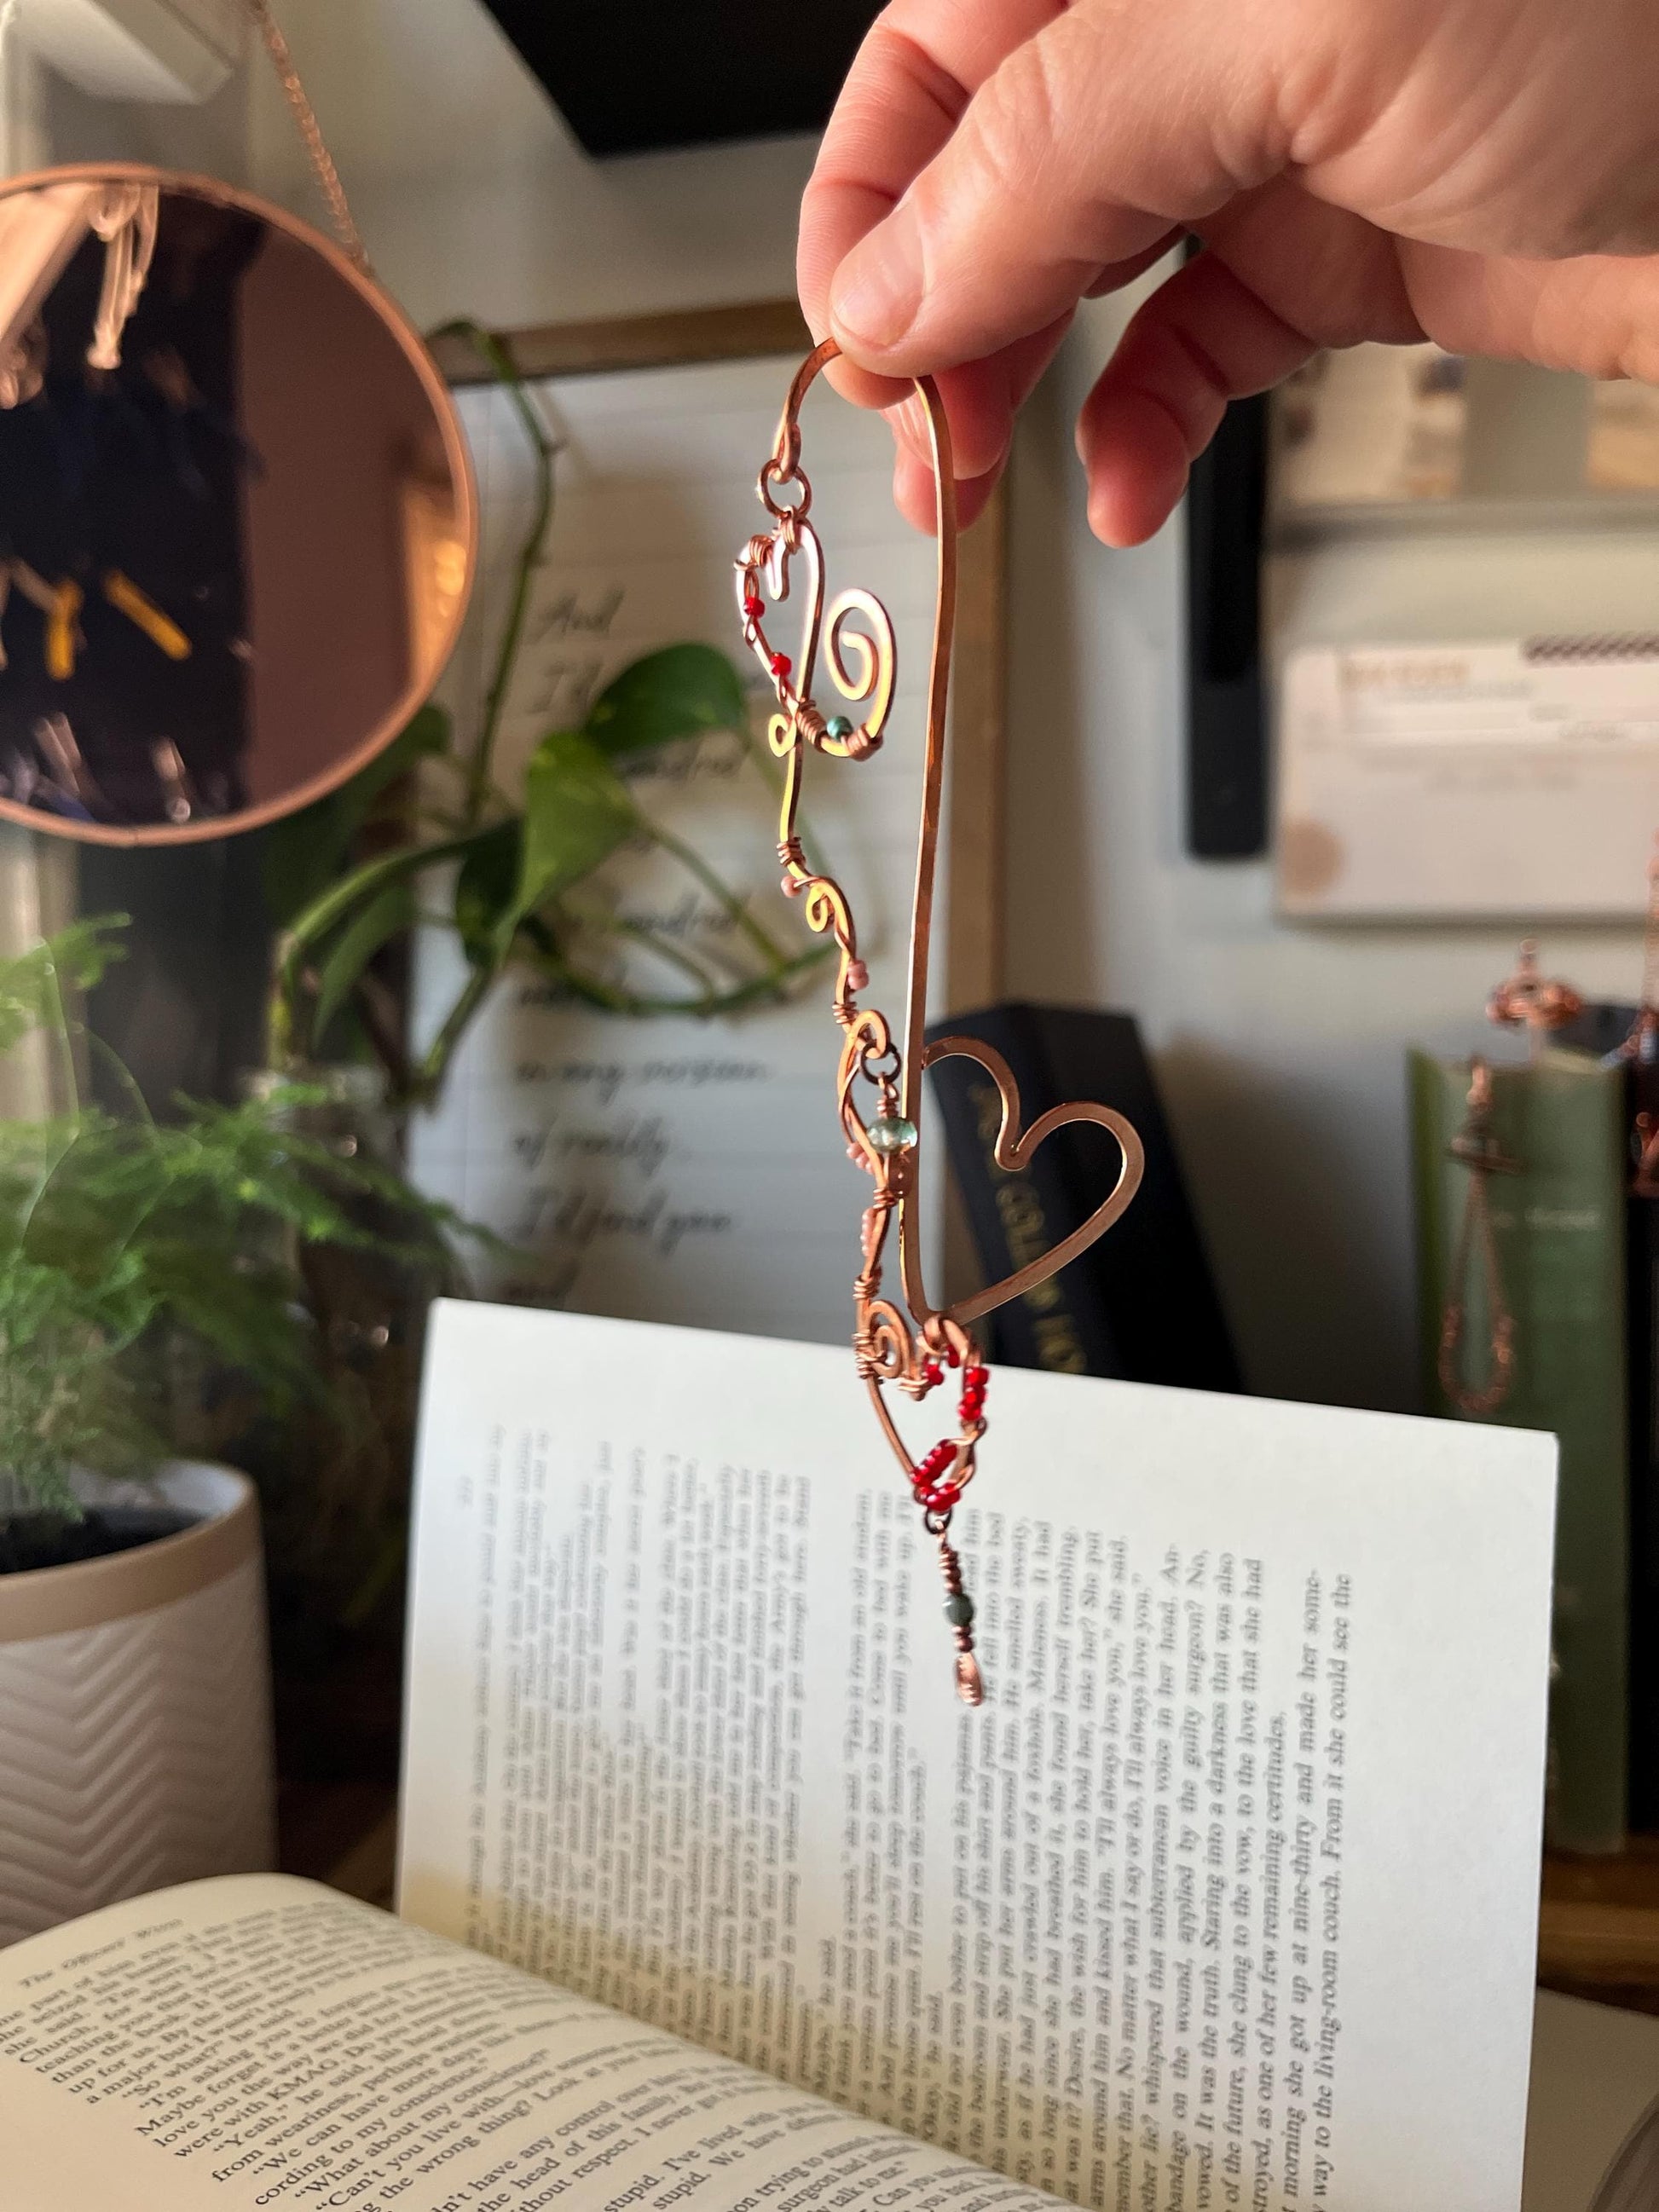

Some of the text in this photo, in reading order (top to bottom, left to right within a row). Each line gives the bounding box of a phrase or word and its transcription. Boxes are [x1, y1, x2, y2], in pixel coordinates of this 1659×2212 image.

[1264, 1708, 1289, 1824] certitudes,
[1223, 1556, 1263, 2203] of the future, she clung to the vow, to the love that she had
[1260, 1827, 1287, 1943] remaining
[1280, 1568, 1322, 2198] morning she got up at nine-thirty and made her some-
[1314, 1572, 1351, 2199] way to the living-room couch. From it she could see the
[1258, 1943, 1278, 1985] few
[1256, 2031, 1275, 2057] of
[1257, 1990, 1275, 2027] her
[36, 2030, 118, 2073] teaching
[52, 2059, 96, 2083] than
[68, 2059, 127, 2094] up for
[86, 2043, 194, 2104] a major but
[139, 2086, 187, 2109] “I’m
[192, 2049, 254, 2083] asking
[255, 2029, 292, 2050] you
[1259, 2061, 1273, 2101] one
[122, 2080, 161, 2099] “So
[135, 2042, 301, 2136] Maybe forget is a
[153, 2040, 342, 2147] love you the way we
[174, 2042, 375, 2157] were with KMAG. Do
[211, 2053, 431, 2182] from weariness, perhaps
[213, 2104, 287, 2151] “Yeah,”
[295, 2088, 324, 2105] he
[328, 2064, 373, 2088] said,
[253, 2068, 439, 2174] “We can have more
[1258, 2105, 1271, 2128] as
[255, 2155, 332, 2205] cording
[330, 2140, 354, 2154] to
[356, 2117, 387, 2139] my
[295, 2103, 452, 2198] “What about my
[315, 2121, 461, 2212] “Can’t you live
[379, 2178, 413, 2199] the
[416, 2136, 480, 2173] wrong
[477, 2099, 531, 2134] thing?
[467, 2100, 616, 2192] have any control
[510, 2157, 560, 2190] head
[564, 2140, 586, 2157] of
[587, 2122, 622, 2141] this
[572, 2139, 638, 2178] respect.
[653, 2172, 711, 2212] stupid.
[708, 2151, 745, 2166] We
[662, 2150, 701, 2171] I’ve
[697, 2125, 743, 2150] lived
[754, 2157, 824, 2197] trying to
[829, 2177, 881, 2208] talk to
[872, 2187, 911, 2207] Can
